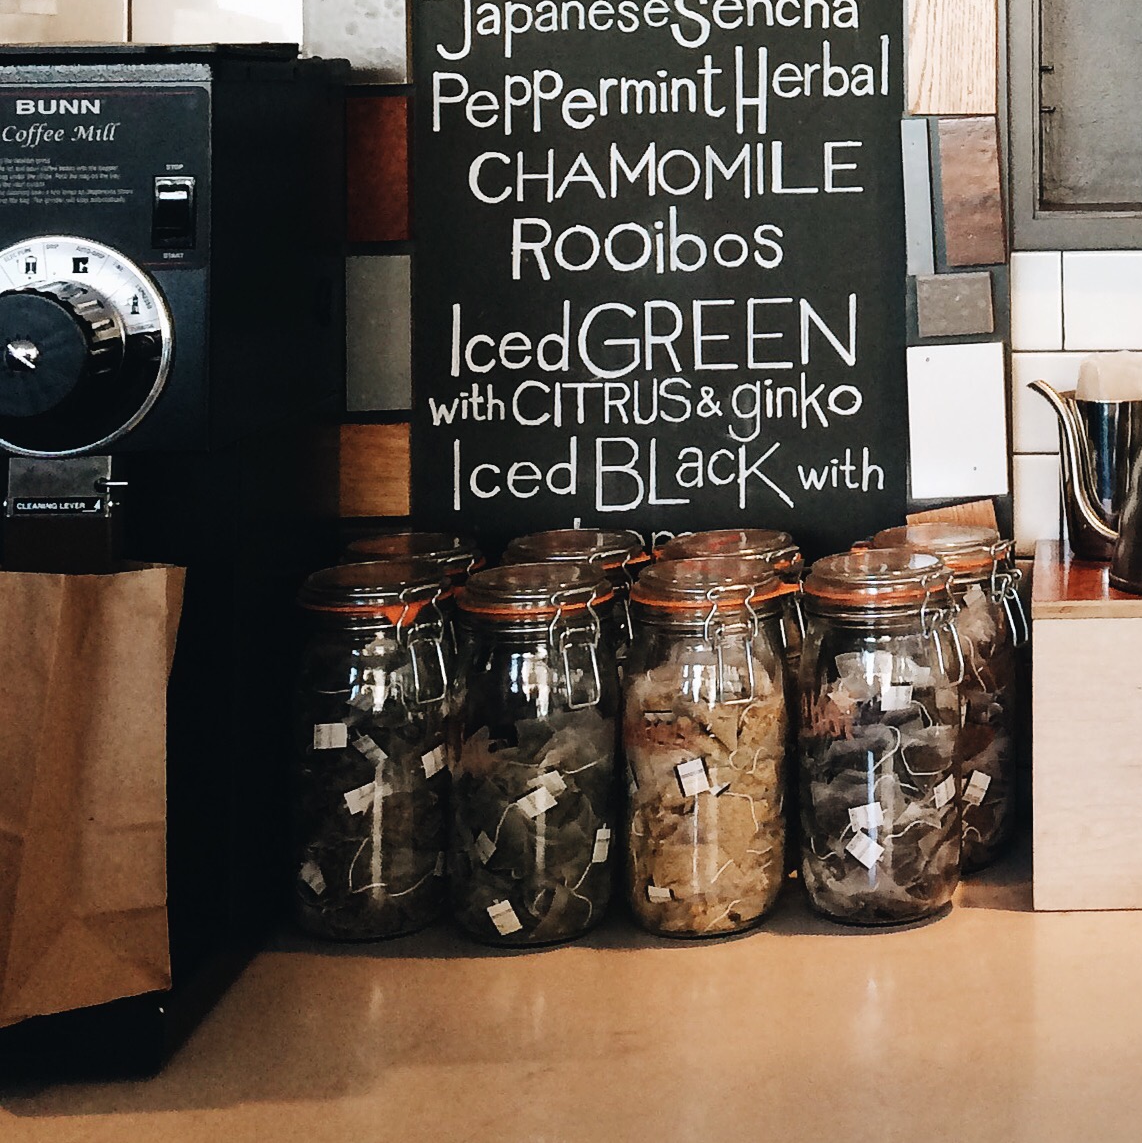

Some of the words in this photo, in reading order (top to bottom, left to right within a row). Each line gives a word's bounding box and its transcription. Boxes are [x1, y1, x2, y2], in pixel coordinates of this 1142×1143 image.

[16, 99, 100, 115] BUNN
[734, 34, 890, 135] Herbal
[2, 122, 65, 148] Coffee
[70, 122, 121, 142] Mill
[468, 140, 864, 204] CHAMOMILE
[450, 299, 571, 377] Iced
[577, 292, 858, 380] GREEN
[428, 383, 506, 427] with
[512, 377, 693, 427] CITRUS
[696, 385, 724, 418] &
[727, 371, 864, 444] ginko
[16, 502, 58, 510] CLEANING
[59, 502, 86, 510] LEVER
[453, 435, 578, 512] Iced
[797, 446, 885, 492] with
